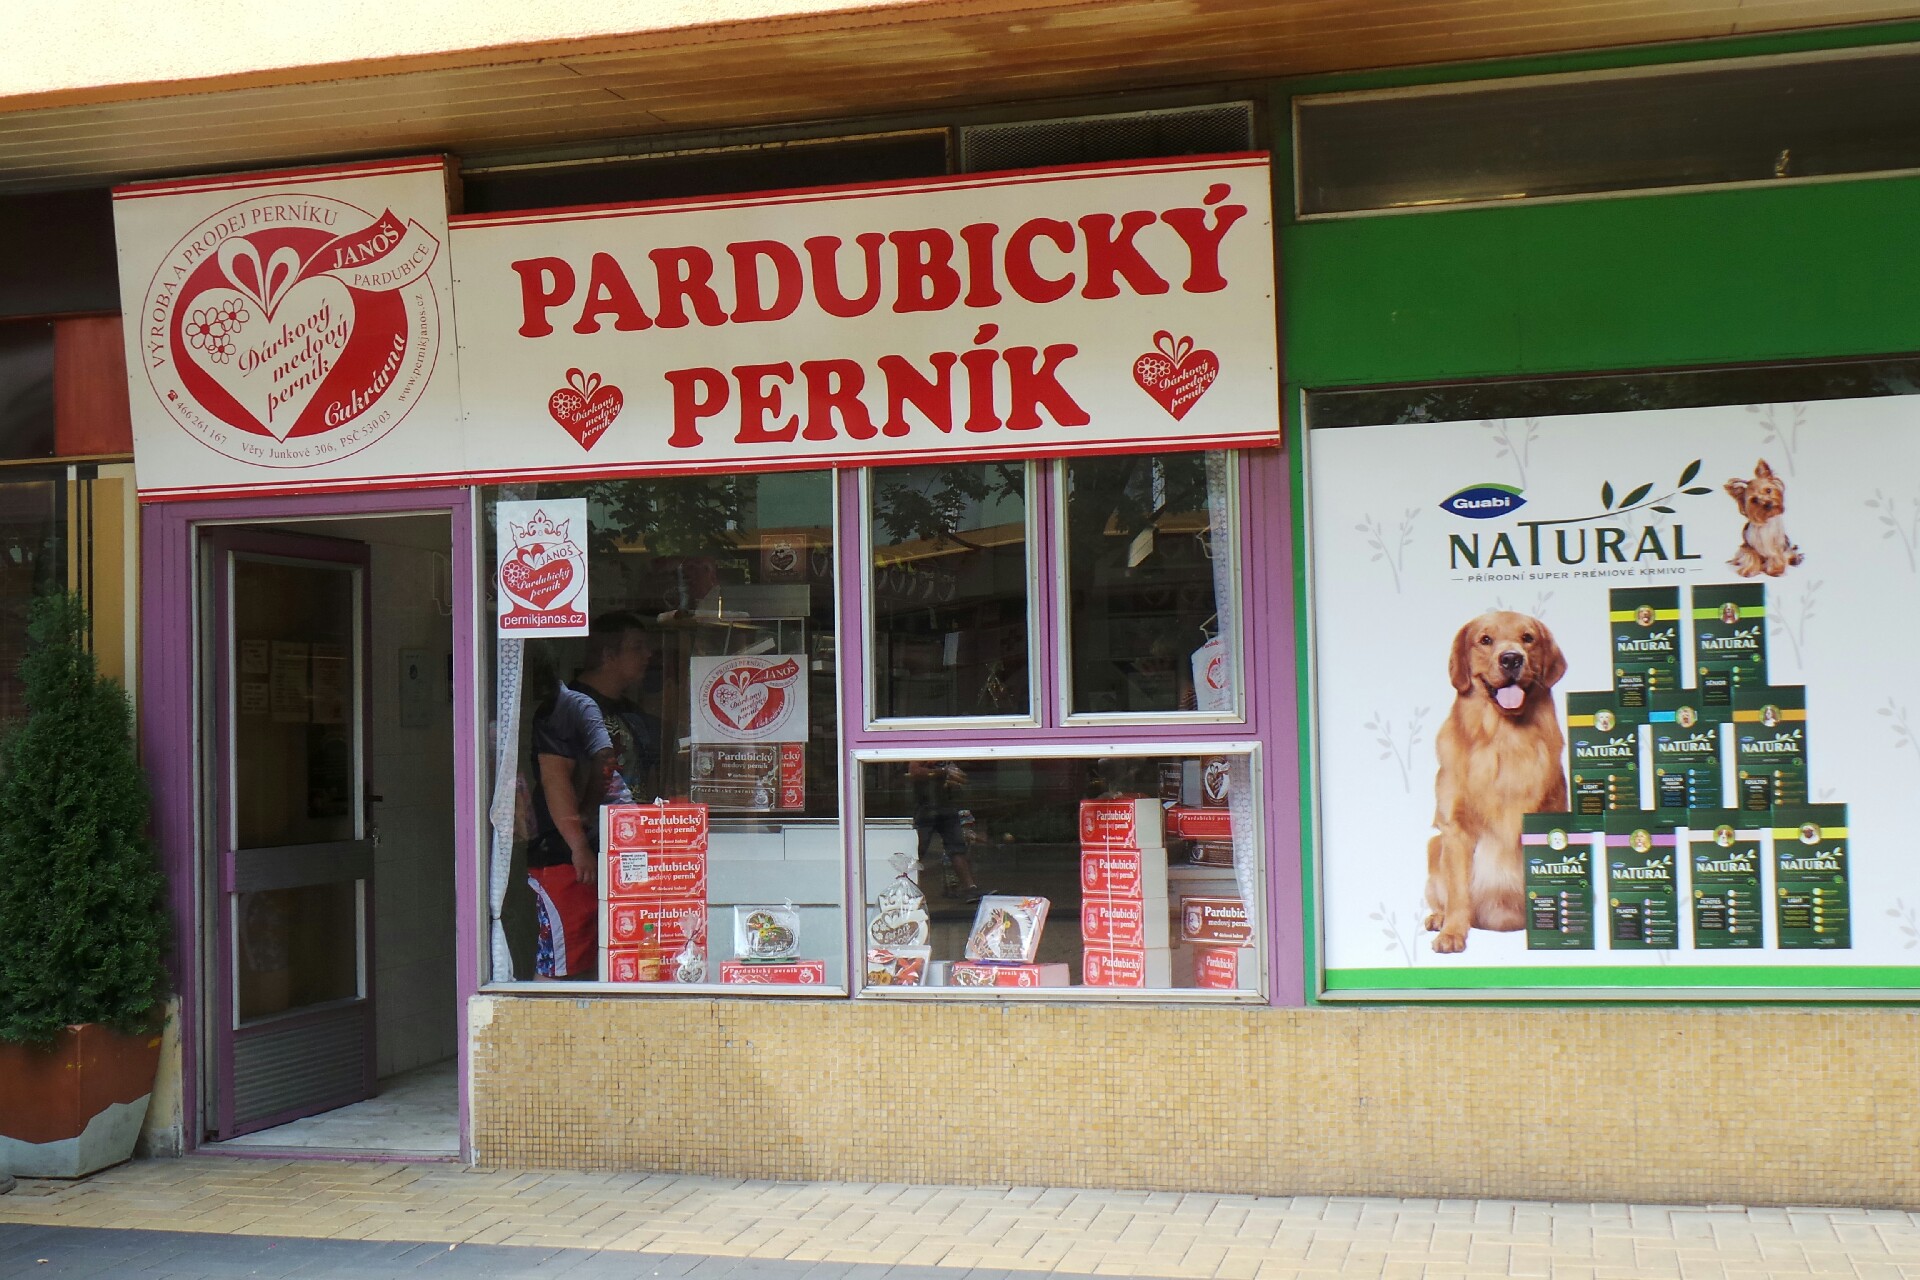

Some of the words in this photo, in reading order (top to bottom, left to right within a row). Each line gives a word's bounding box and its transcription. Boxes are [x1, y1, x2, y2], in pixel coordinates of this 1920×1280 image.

[333, 221, 399, 269] JANOŠ
[354, 244, 430, 286] PARDUBICE
[511, 183, 1248, 338] PARDUBICKÝ
[147, 282, 177, 368] VÝROBA
[173, 265, 187, 280] A
[182, 213, 247, 265] PRODEJ
[251, 201, 339, 226] PERNÍKU
[238, 298, 330, 378] Dárkový
[273, 313, 348, 383] medový
[398, 294, 430, 402] www.pernikjanos.cz
[324, 331, 406, 427] Cukrárna
[1159, 358, 1209, 391] Dárkový
[268, 353, 330, 423] perník
[664, 323, 1091, 448] PERNÍK
[176, 402, 192, 419] 466
[191, 416, 208, 433] 261
[209, 430, 227, 445] 167
[242, 442, 265, 458] Věry
[269, 448, 311, 459] Junkové
[340, 430, 360, 447] PSČ
[363, 419, 379, 437] 530
[379, 410, 391, 424] 03
[1452, 496, 1511, 509] Guabi
[1448, 521, 1702, 569] NATURAL
[540, 544, 573, 566] JANOŠ
[1467, 571, 1525, 582] PŘÍRODNÍ
[1529, 571, 1568, 580] SUPER
[1573, 567, 1635, 578] PRÉMIOVÉ
[1640, 567, 1686, 576] KRMIVO
[504, 613, 583, 628] pernikjanos.cz
[1617, 638, 1674, 651] NATURAL
[1701, 637, 1759, 649] NATURAL
[1576, 744, 1634, 757] NATURAL
[1658, 740, 1714, 752] NATURAL
[1741, 740, 1800, 753] NATURAL
[718, 751, 773, 763] Pardubický
[640, 814, 702, 826] Pardubický
[647, 861, 700, 873] ardubický
[1530, 863, 1586, 875] NATURAL
[1612, 867, 1671, 879] NATURAL
[1696, 860, 1754, 872] NATURAL
[1780, 858, 1841, 870] NATURAL
